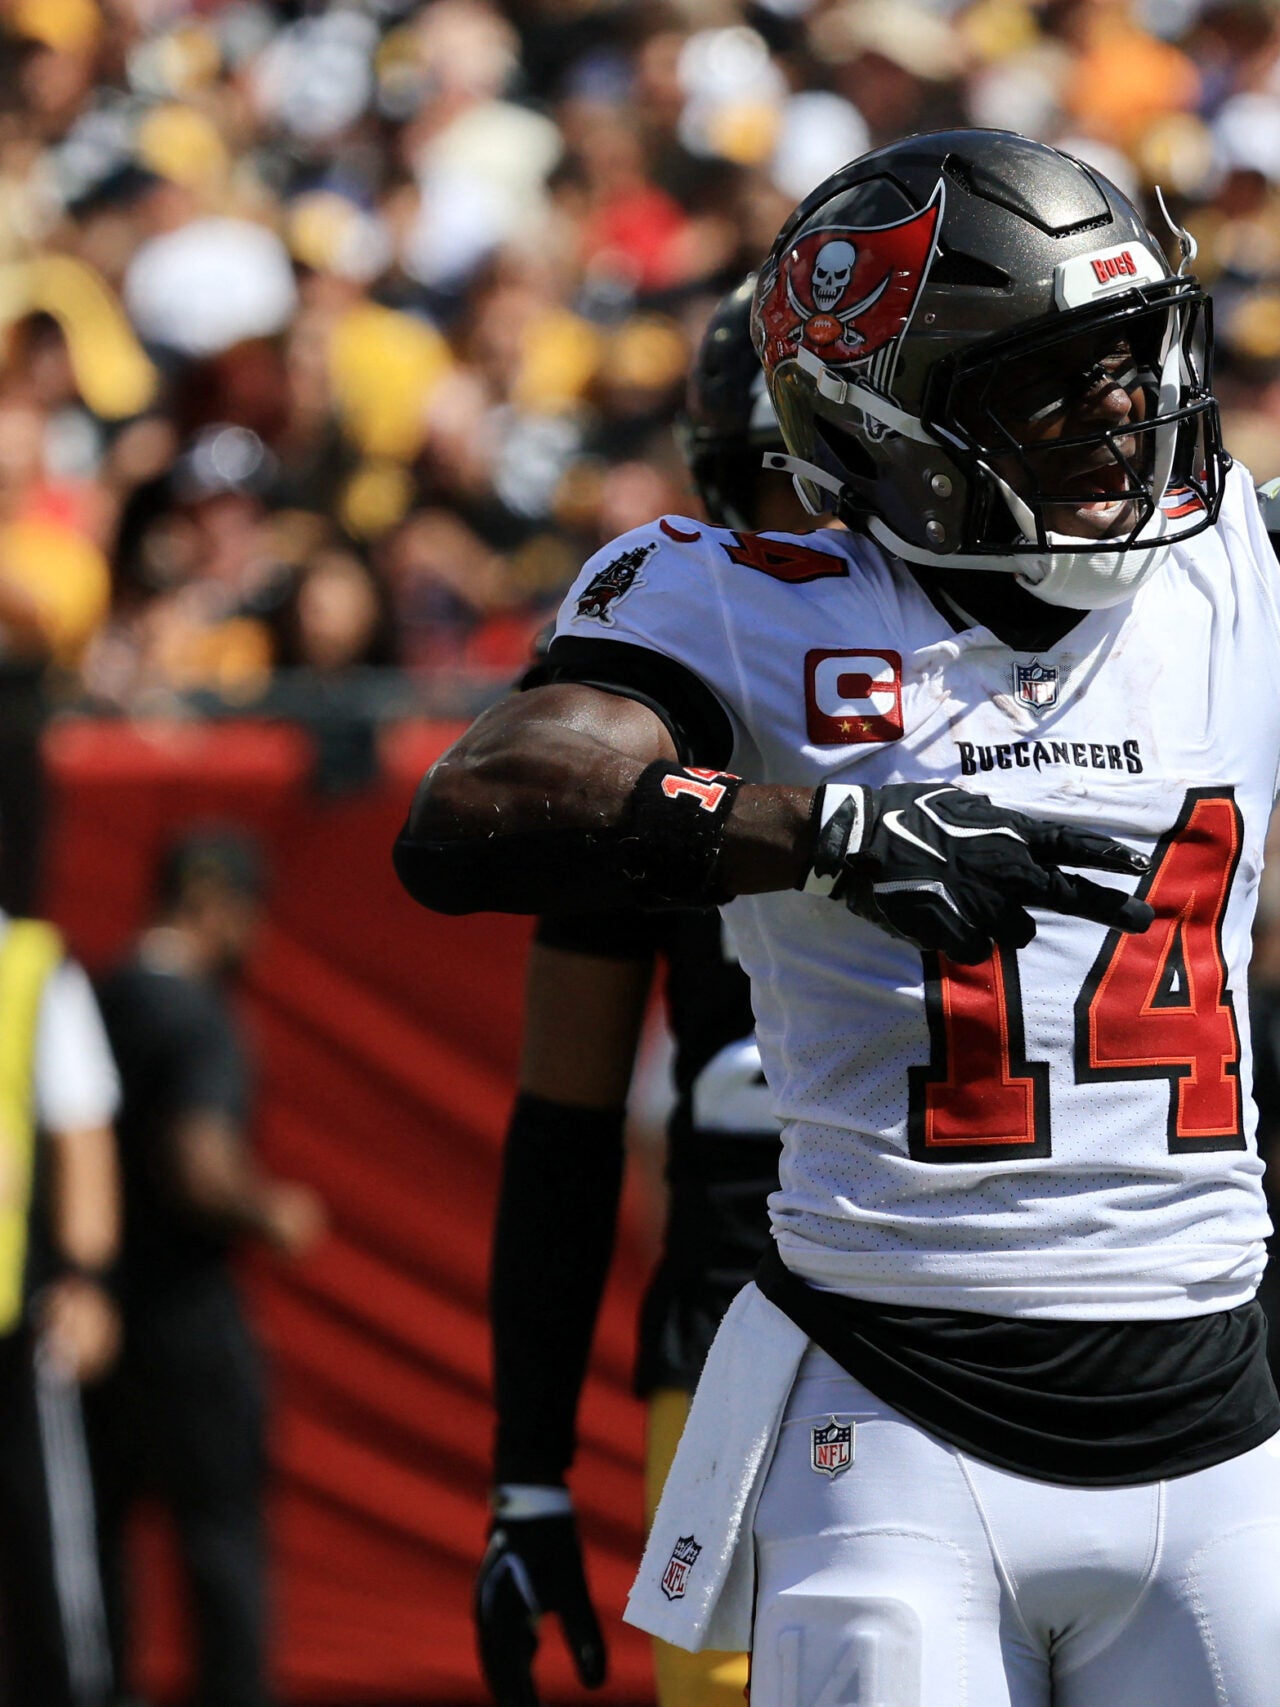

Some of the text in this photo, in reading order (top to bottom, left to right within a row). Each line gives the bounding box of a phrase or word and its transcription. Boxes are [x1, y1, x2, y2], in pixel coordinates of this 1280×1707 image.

[814, 656, 896, 717] C
[1021, 681, 1054, 704] NFL
[955, 739, 1144, 775] BUCCANEERS
[908, 786, 1247, 1162] 14
[817, 1443, 848, 1467] NFL
[663, 1560, 685, 1594] NFL
